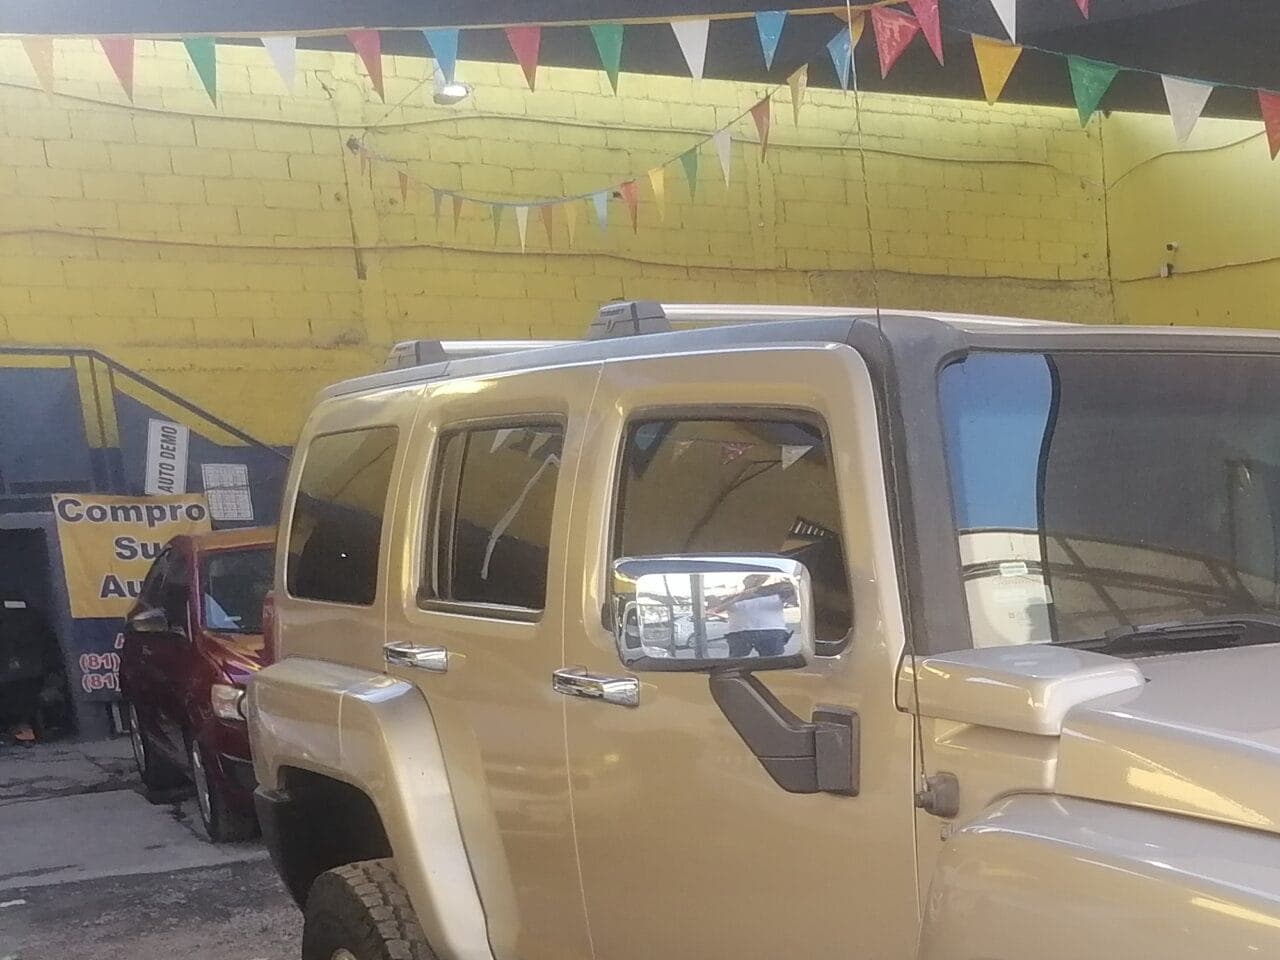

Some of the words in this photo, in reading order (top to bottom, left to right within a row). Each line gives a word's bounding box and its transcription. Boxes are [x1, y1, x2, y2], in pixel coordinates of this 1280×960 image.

[160, 425, 178, 460] DEMO
[157, 461, 175, 494] AUTO
[57, 498, 206, 528] Compro
[80, 652, 121, 673] (81)
